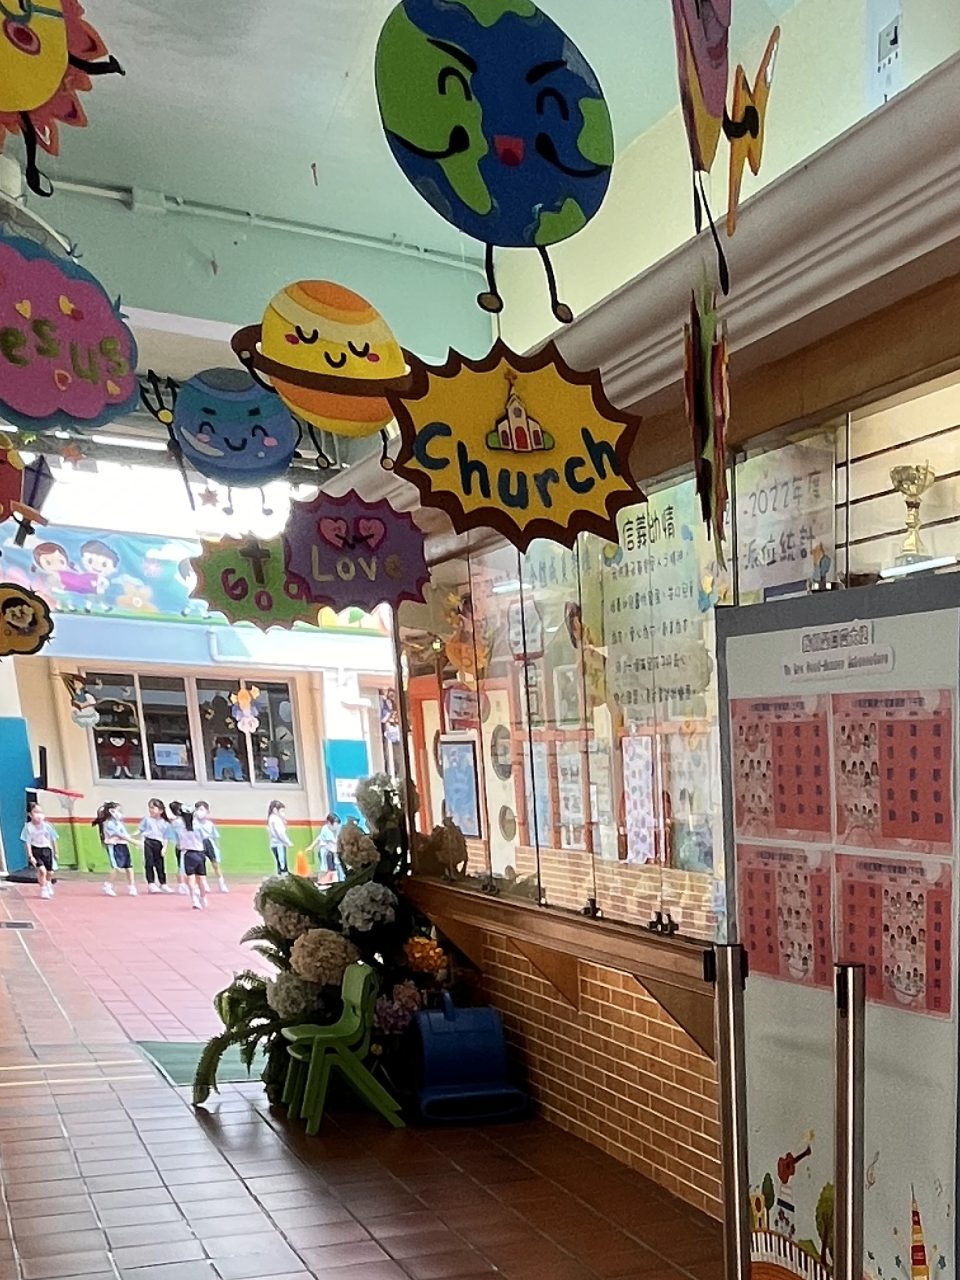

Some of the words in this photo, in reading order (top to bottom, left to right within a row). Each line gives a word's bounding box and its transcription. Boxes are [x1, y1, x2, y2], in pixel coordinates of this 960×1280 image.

[0, 319, 130, 379] esus
[414, 421, 622, 510] Church
[311, 544, 400, 582] Love
